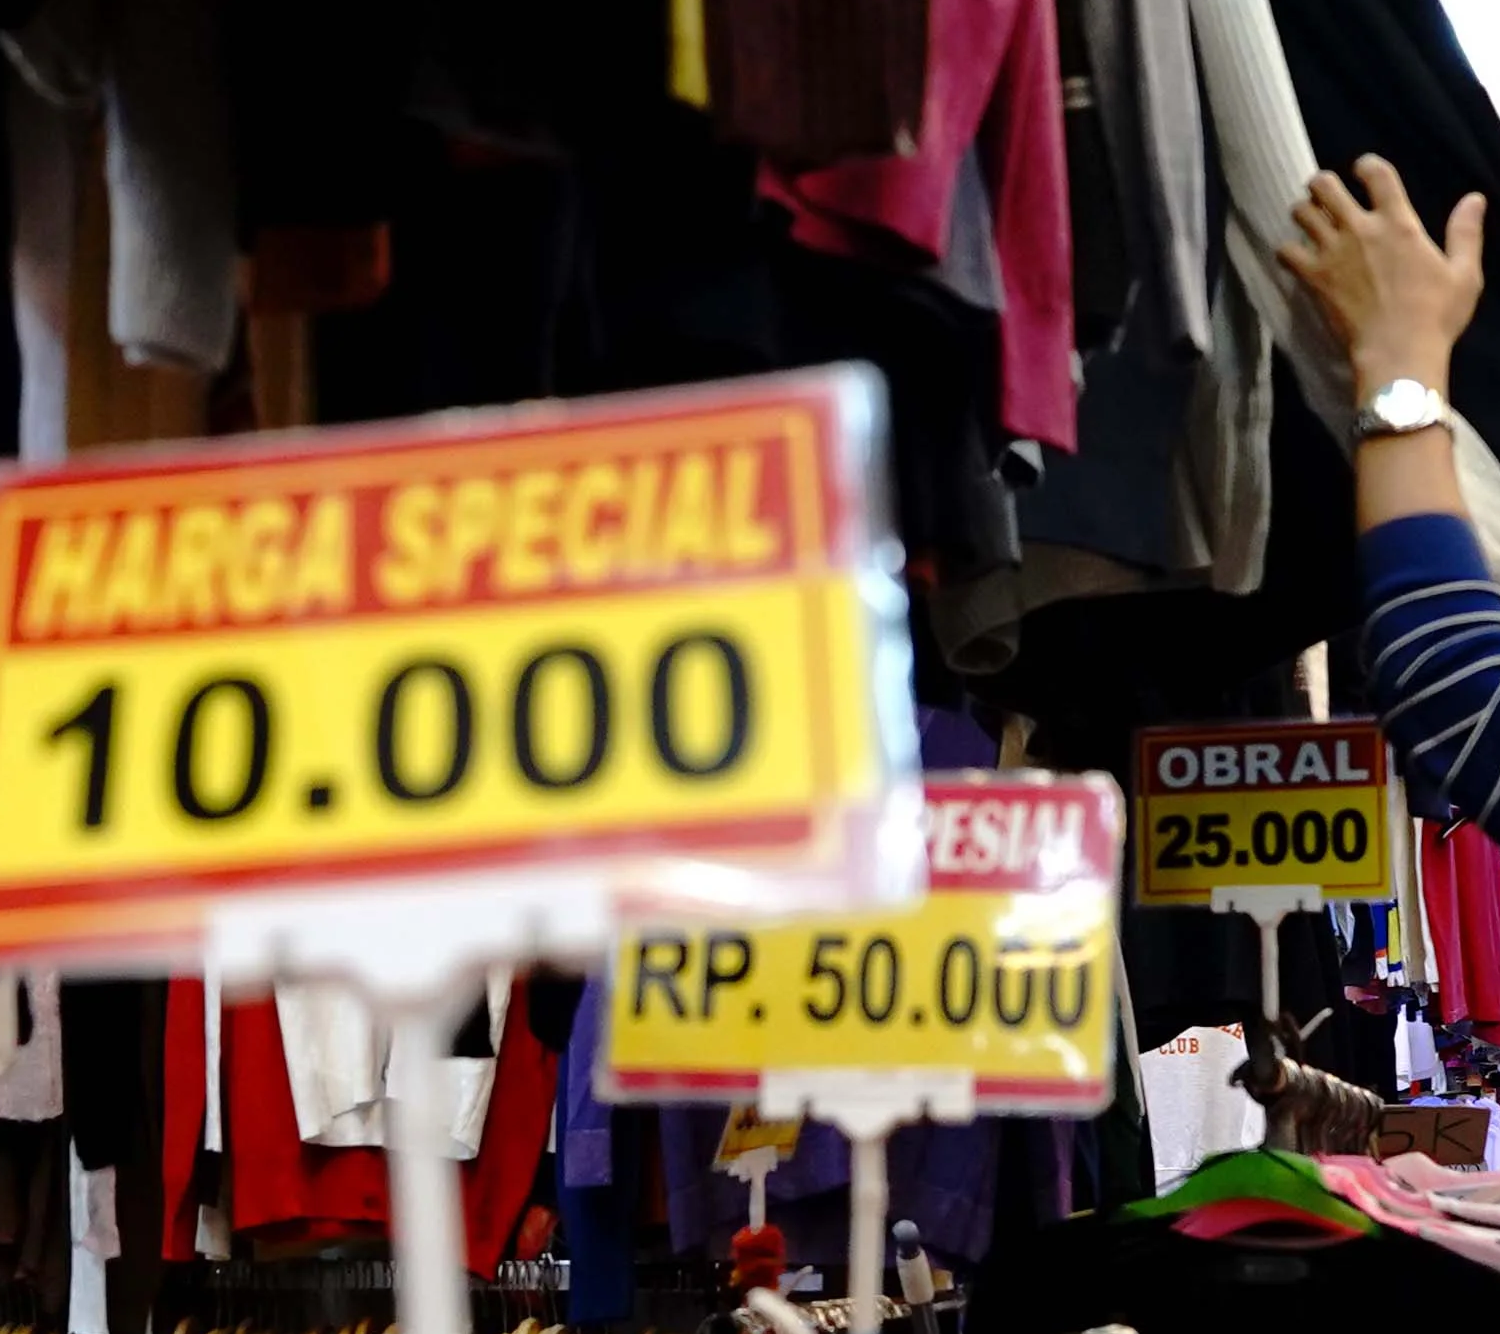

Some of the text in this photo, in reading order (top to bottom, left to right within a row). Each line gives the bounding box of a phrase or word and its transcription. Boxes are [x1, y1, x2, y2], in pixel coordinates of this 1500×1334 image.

[25, 450, 777, 629] HARGA SPECIAL
[46, 630, 754, 830] 10.000
[1157, 739, 1370, 788] OBRAL
[1154, 806, 1368, 869] 25.000
[630, 930, 1091, 1029] RP. 50.000
